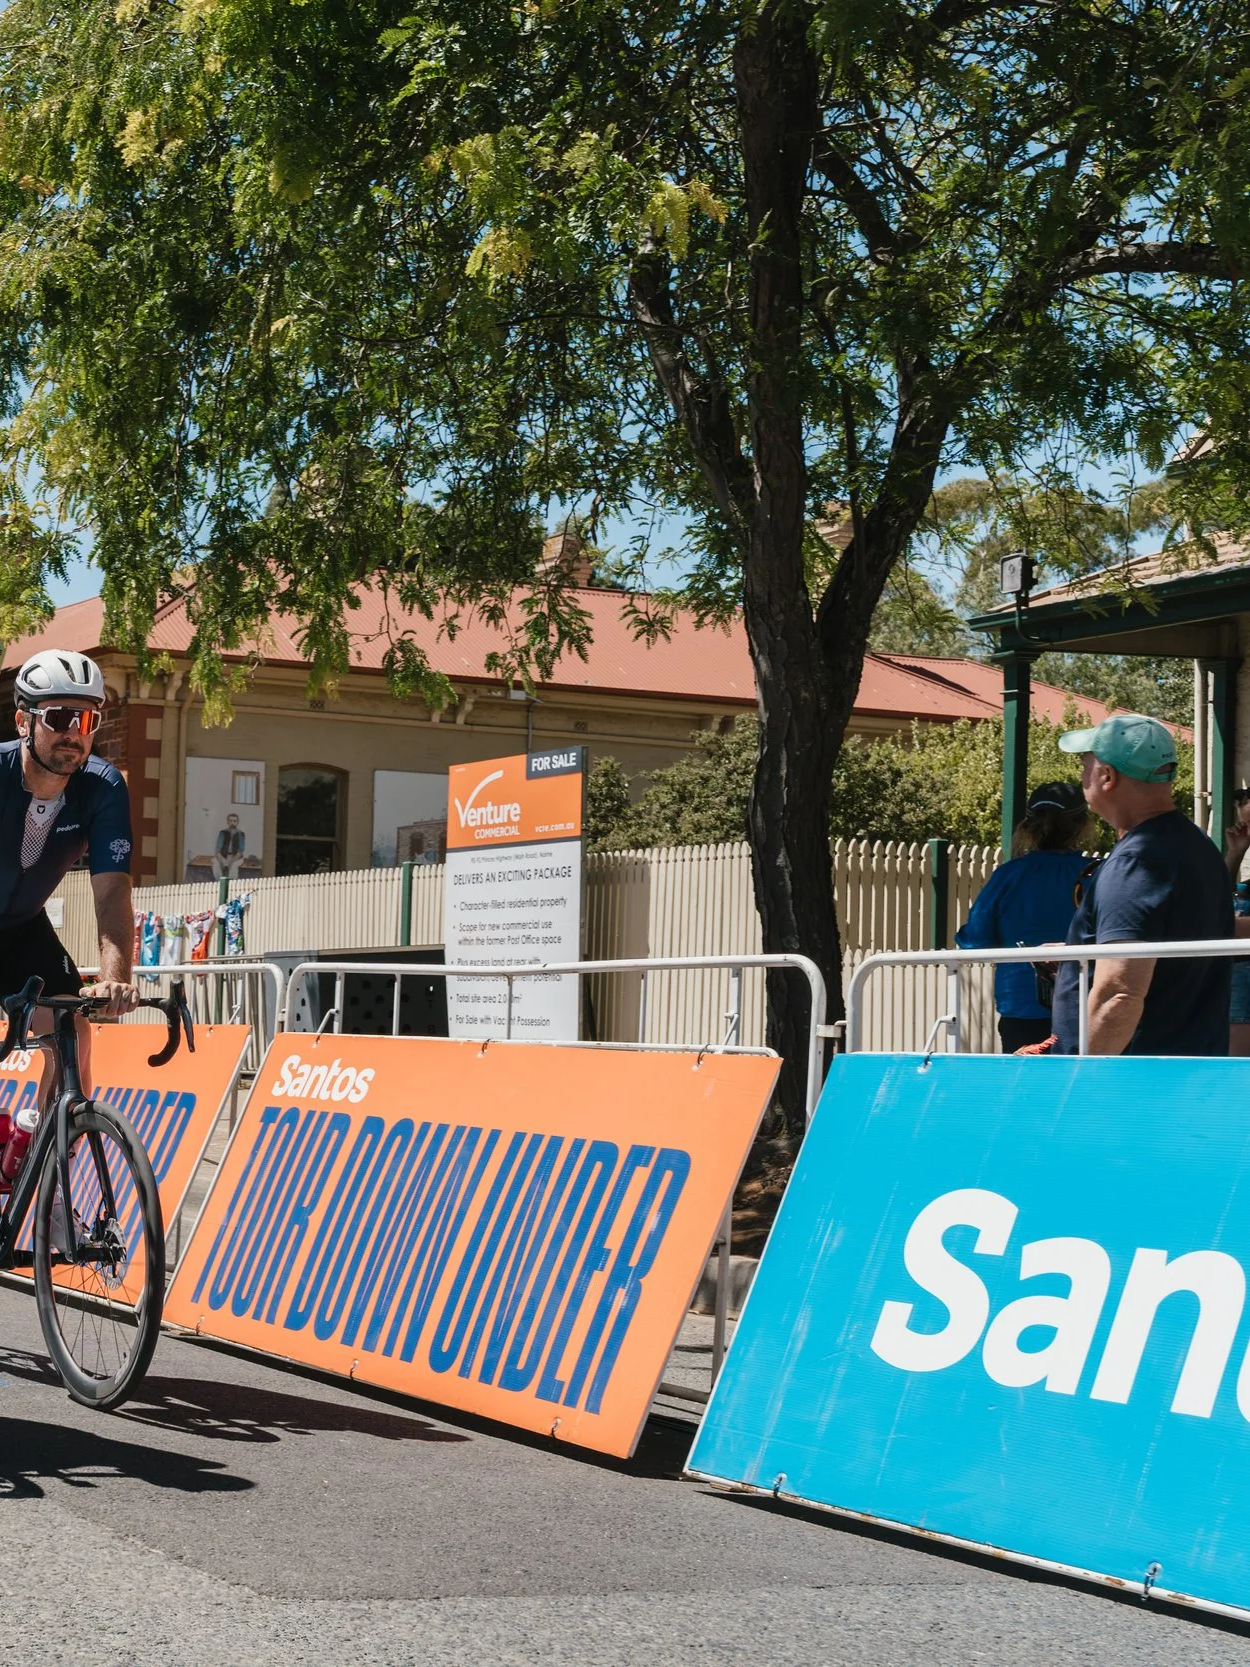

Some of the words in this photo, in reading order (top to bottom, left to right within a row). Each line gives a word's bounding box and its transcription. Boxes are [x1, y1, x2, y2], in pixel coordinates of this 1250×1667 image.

[454, 770, 520, 829] Venture
[474, 825, 520, 840] COMMERCIAL
[535, 822, 575, 833] vcre.com.au
[453, 872, 484, 885] DELIVERS
[485, 872, 496, 883] AN
[498, 869, 532, 882] EXCITING
[534, 866, 572, 880] PACKAGE
[460, 899, 505, 911] Character-filled
[507, 898, 538, 909] residential
[540, 896, 567, 909] property
[459, 923, 477, 933] Scope
[479, 922, 487, 931] for
[488, 923, 500, 931] new
[502, 920, 540, 931] commercial
[541, 921, 553, 929] use
[458, 937, 474, 946] within
[476, 936, 485, 945] the
[486, 935, 505, 945] former
[507, 935, 520, 945] Post
[521, 934, 540, 945] Office
[541, 935, 562, 947] space
[457, 957, 468, 966] Plus
[491, 957, 505, 966] land
[528, 957, 541, 965] with
[456, 993, 470, 1003] Total
[471, 993, 481, 1003] site
[483, 994, 496, 1003] area
[456, 1015, 464, 1024] For
[466, 1015, 478, 1025] Sale
[480, 1015, 491, 1025] with
[517, 1016, 550, 1027] Possession
[272, 1054, 376, 1103] Santos
[191, 1106, 350, 1323] TOUR
[283, 1116, 500, 1364] DOWN
[428, 1130, 692, 1416] UNDER
[870, 1187, 1250, 1424] San
